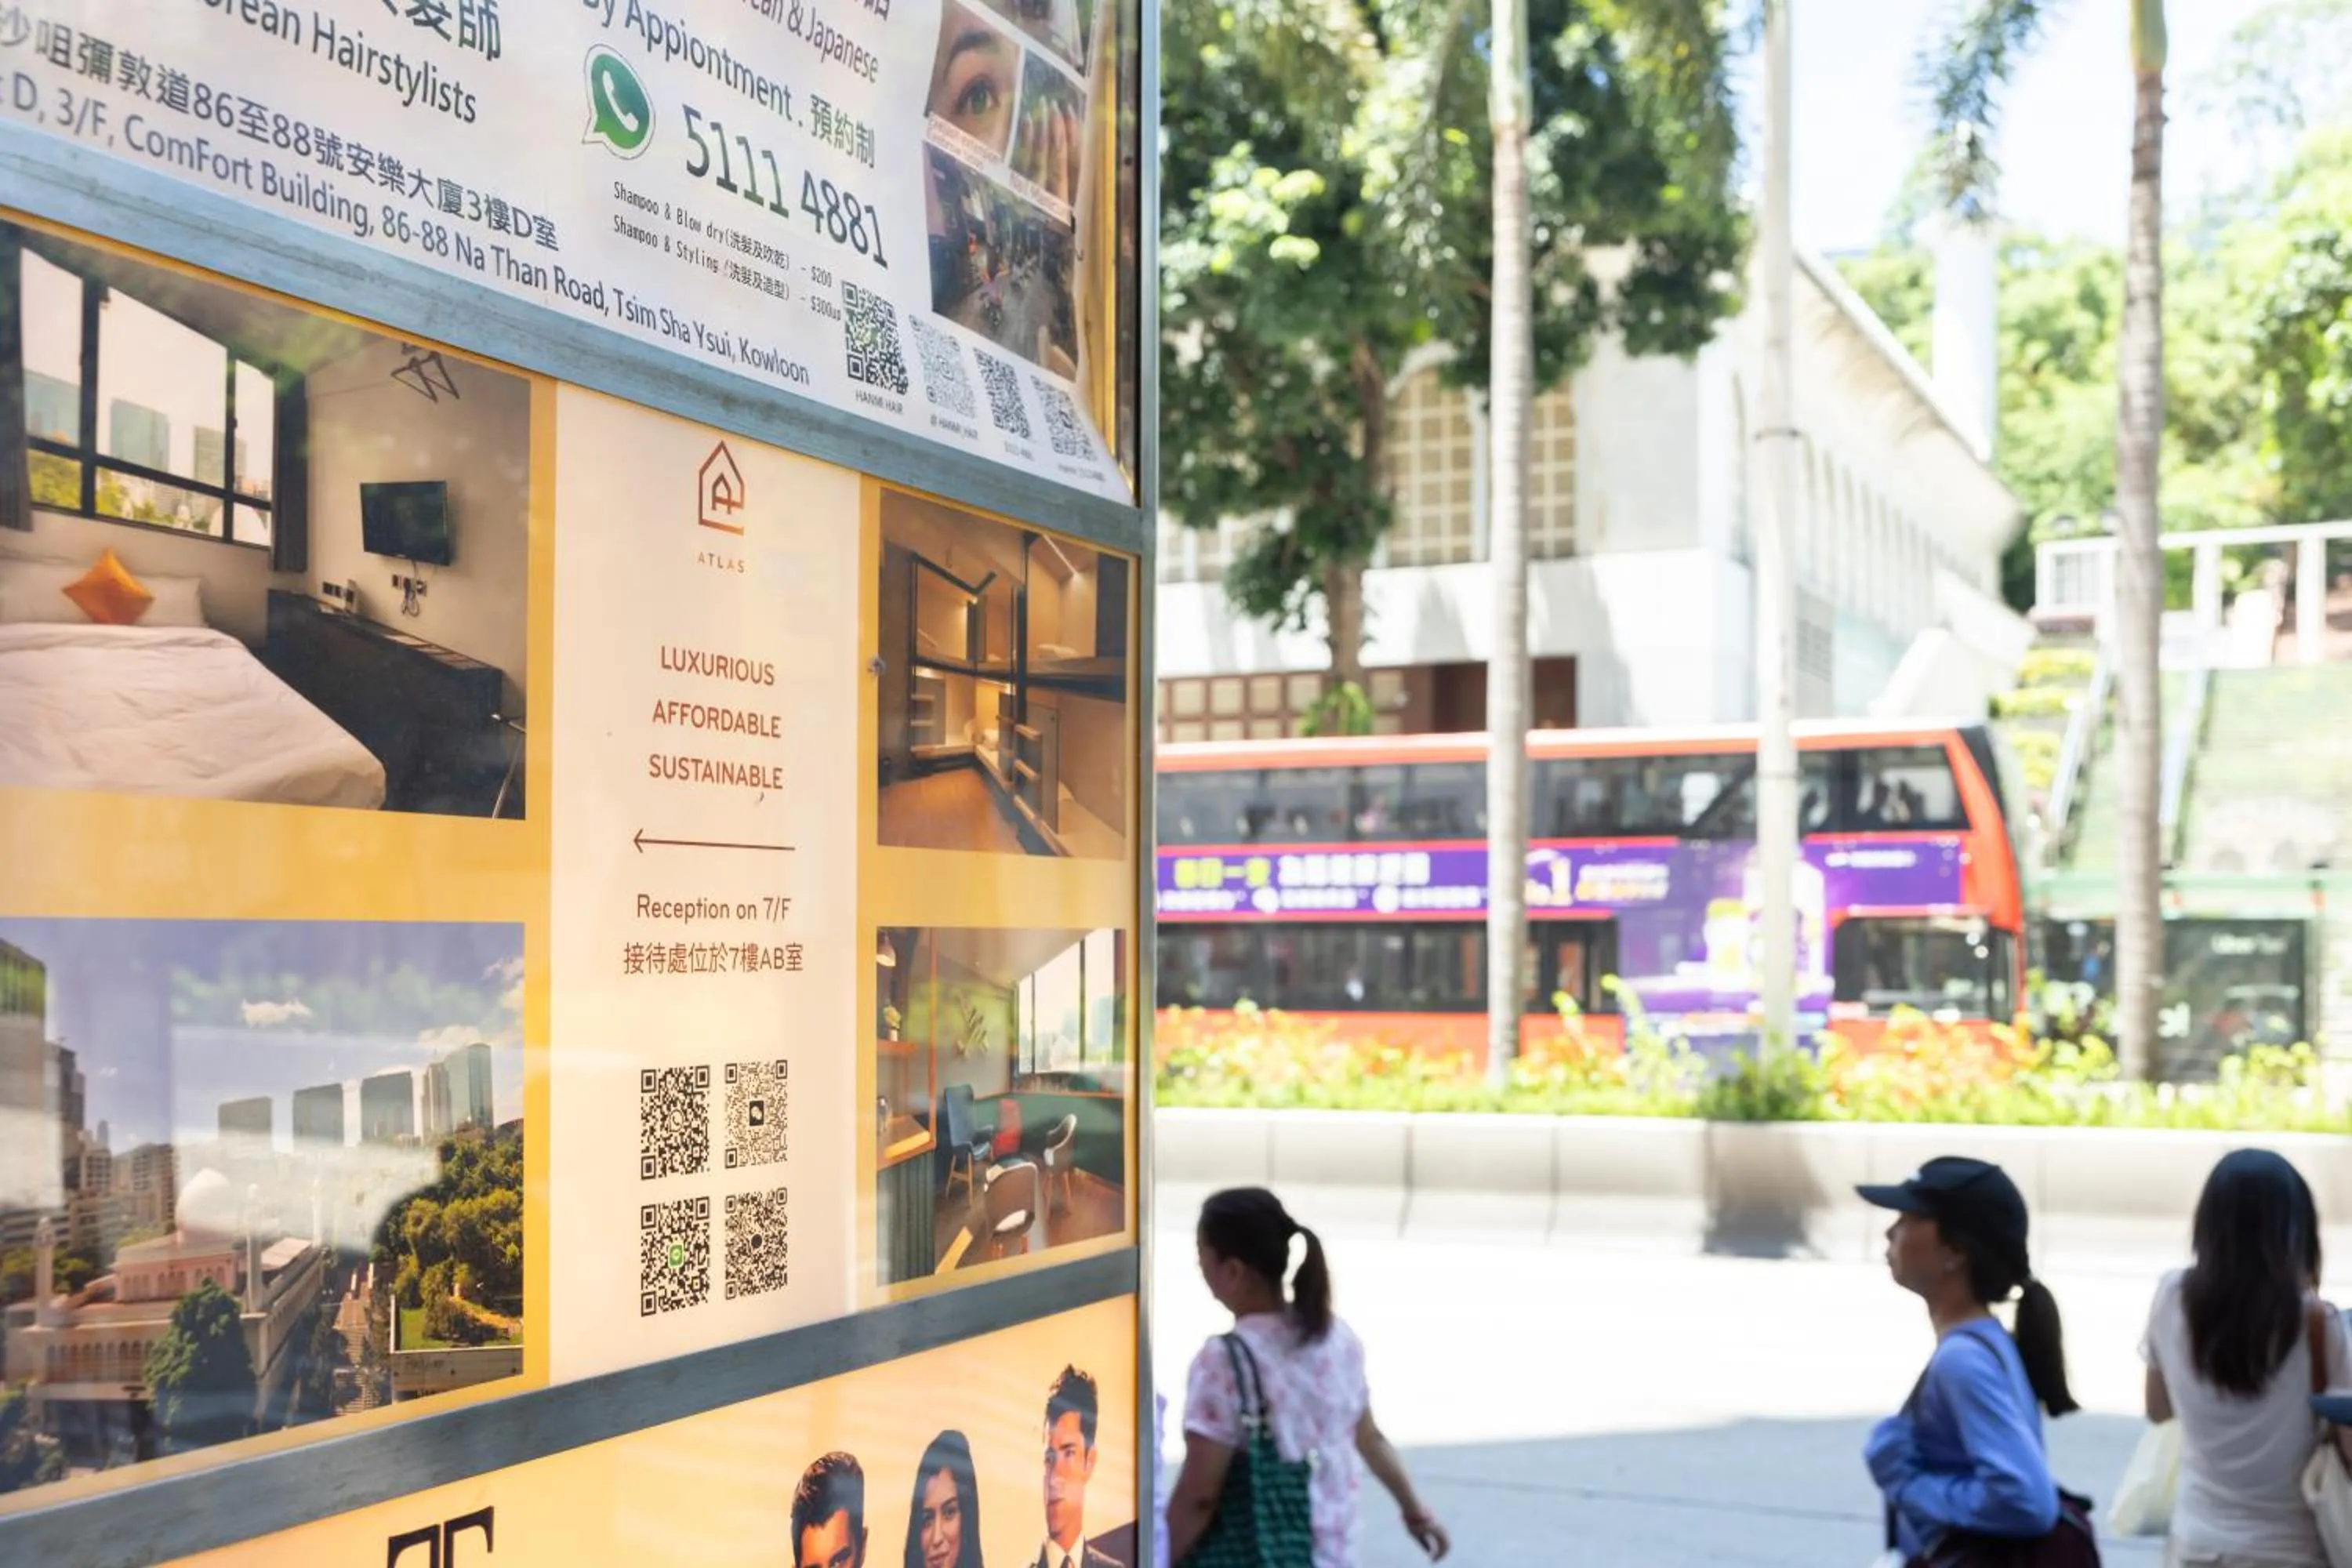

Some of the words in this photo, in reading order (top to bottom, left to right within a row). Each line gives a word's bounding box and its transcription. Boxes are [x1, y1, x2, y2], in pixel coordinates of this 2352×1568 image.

[787, 0, 804, 37] &
[805, 6, 879, 83] Japanese
[311, 11, 477, 125] Hairstylists
[810, 93, 875, 169] 預約制
[614, 181, 659, 216] Shampoo
[664, 201, 672, 221] &
[677, 207, 702, 233] Blow
[681, 103, 789, 220] 5111
[800, 169, 888, 270] 4881
[56, 87, 114, 147] 3/F,
[124, 114, 253, 191] ComFort
[261, 160, 375, 237] Building,
[382, 204, 449, 257] 86-88
[455, 231, 485, 272] Na
[490, 244, 547, 291] Than
[554, 265, 609, 317] Road,
[612, 287, 657, 331] Tsim
[659, 307, 691, 344] Sha
[692, 319, 736, 363] Ysui,
[739, 336, 811, 386] Kowloon
[614, 214, 659, 249] Shampoo
[677, 240, 719, 274] Styling
[697, 551, 746, 574] ATLAS
[660, 644, 775, 686] LUXURIOUS
[652, 698, 782, 739] AFFORDABLE
[648, 753, 784, 790] SUSTAINABLE
[636, 893, 731, 925] Reception
[735, 902, 758, 920] on
[762, 895, 792, 924] 7/F
[623, 941, 804, 975] 接待處位於7樓AB室
